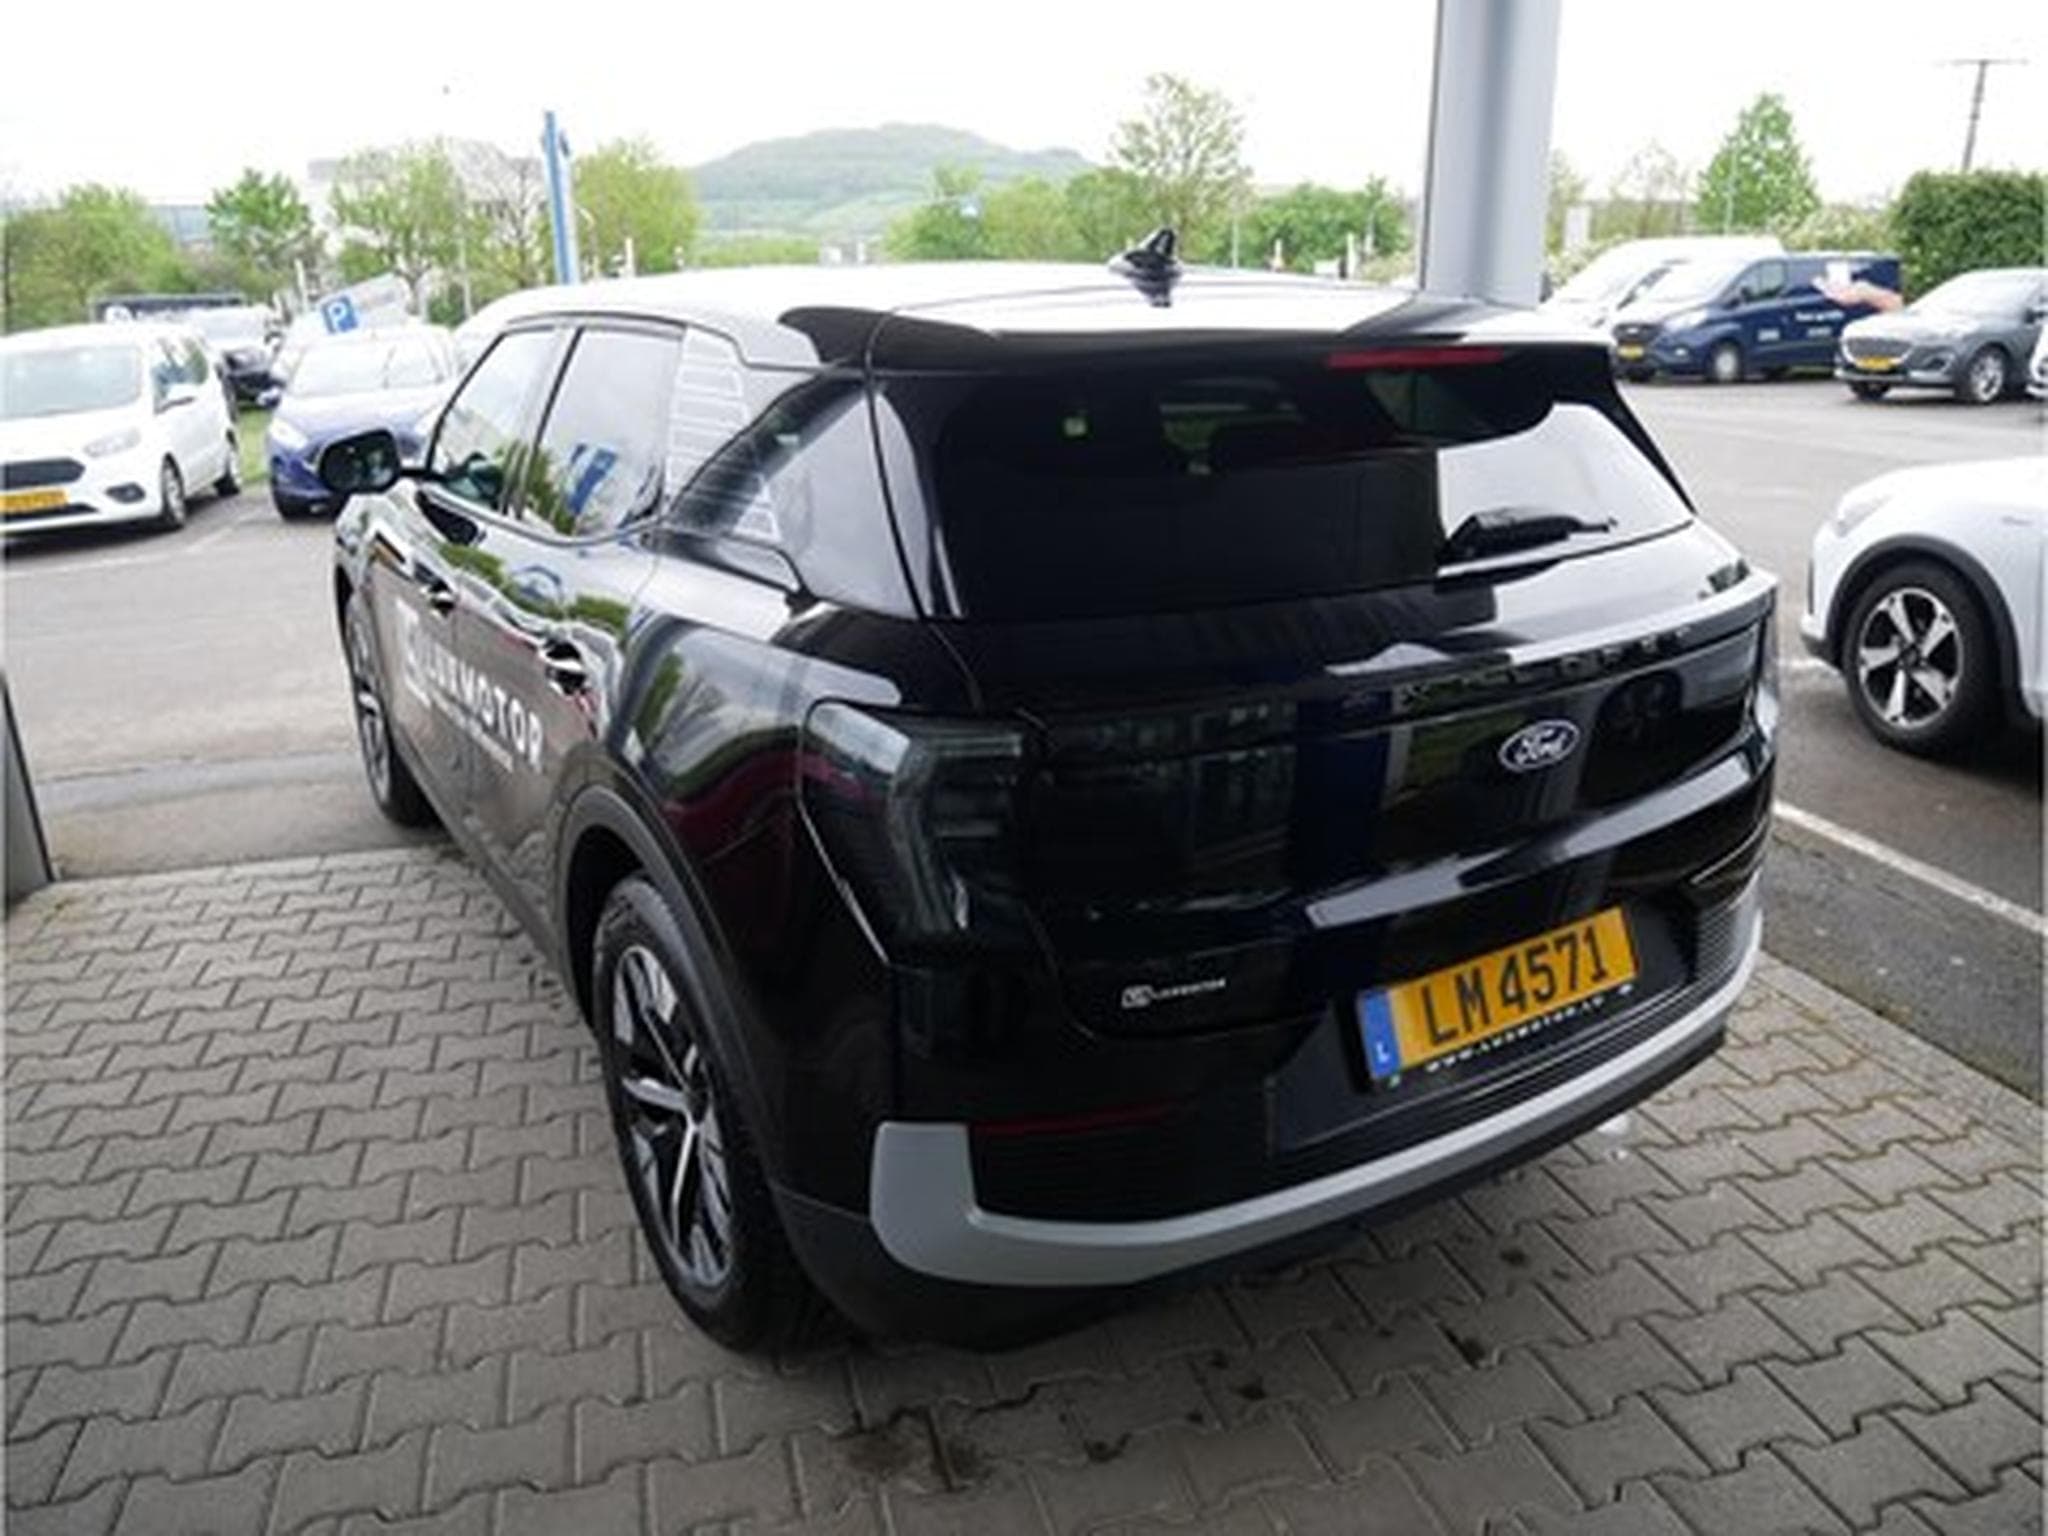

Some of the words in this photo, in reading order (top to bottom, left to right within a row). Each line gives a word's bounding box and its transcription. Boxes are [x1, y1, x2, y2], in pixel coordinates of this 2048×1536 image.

[328, 302, 349, 332] P
[1419, 966, 1491, 1047] LM
[1499, 925, 1609, 1016] 4571
